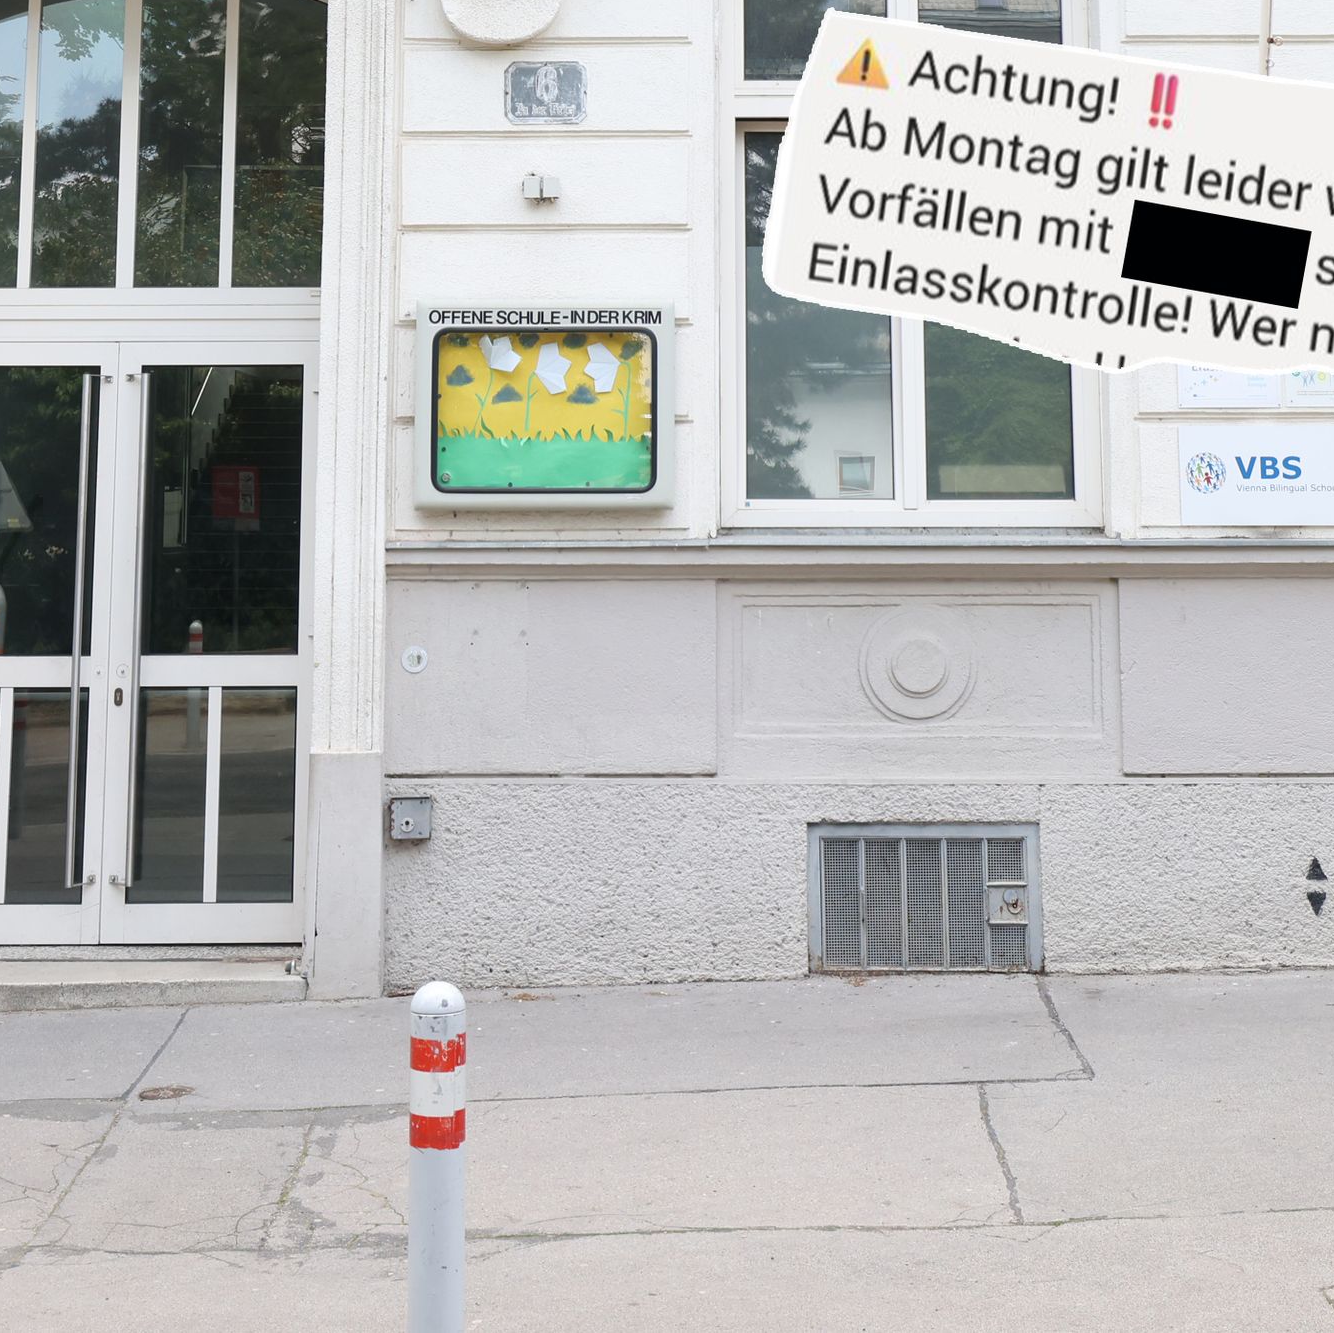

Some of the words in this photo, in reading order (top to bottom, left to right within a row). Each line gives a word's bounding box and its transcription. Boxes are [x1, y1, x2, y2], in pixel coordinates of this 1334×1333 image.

[535, 66, 557, 102] 6
[428, 309, 494, 325] OFFENE
[495, 310, 561, 325] SCHULE
[570, 310, 585, 324] IN
[587, 310, 619, 325] DER
[622, 310, 662, 325] KRIM
[1234, 455, 1303, 481] VBS
[1236, 483, 1267, 493] Vienna
[1269, 482, 1308, 494] Bilingual
